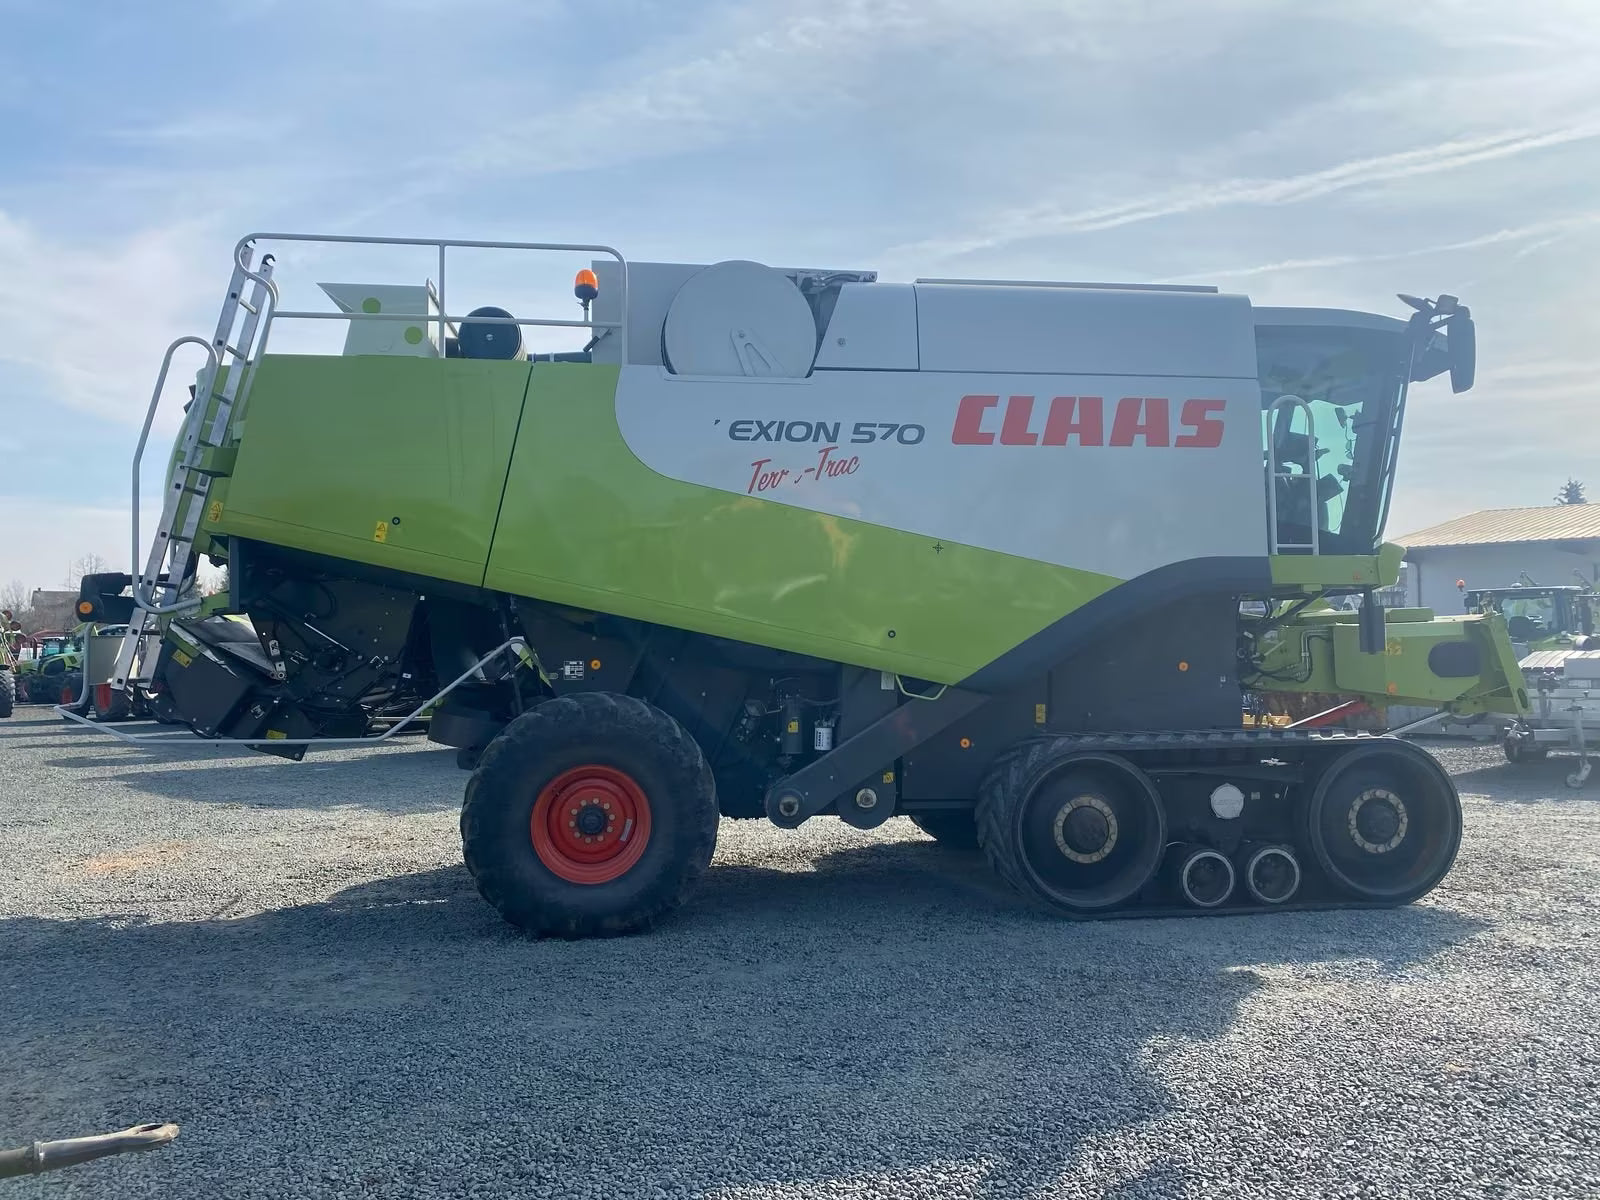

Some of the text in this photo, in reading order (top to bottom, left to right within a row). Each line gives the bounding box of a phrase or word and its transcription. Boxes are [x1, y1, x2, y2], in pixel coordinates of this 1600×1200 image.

[714, 419, 926, 445] EXION 570
[951, 395, 1227, 448] CLAAS
[747, 446, 860, 494] Terr-Trac
